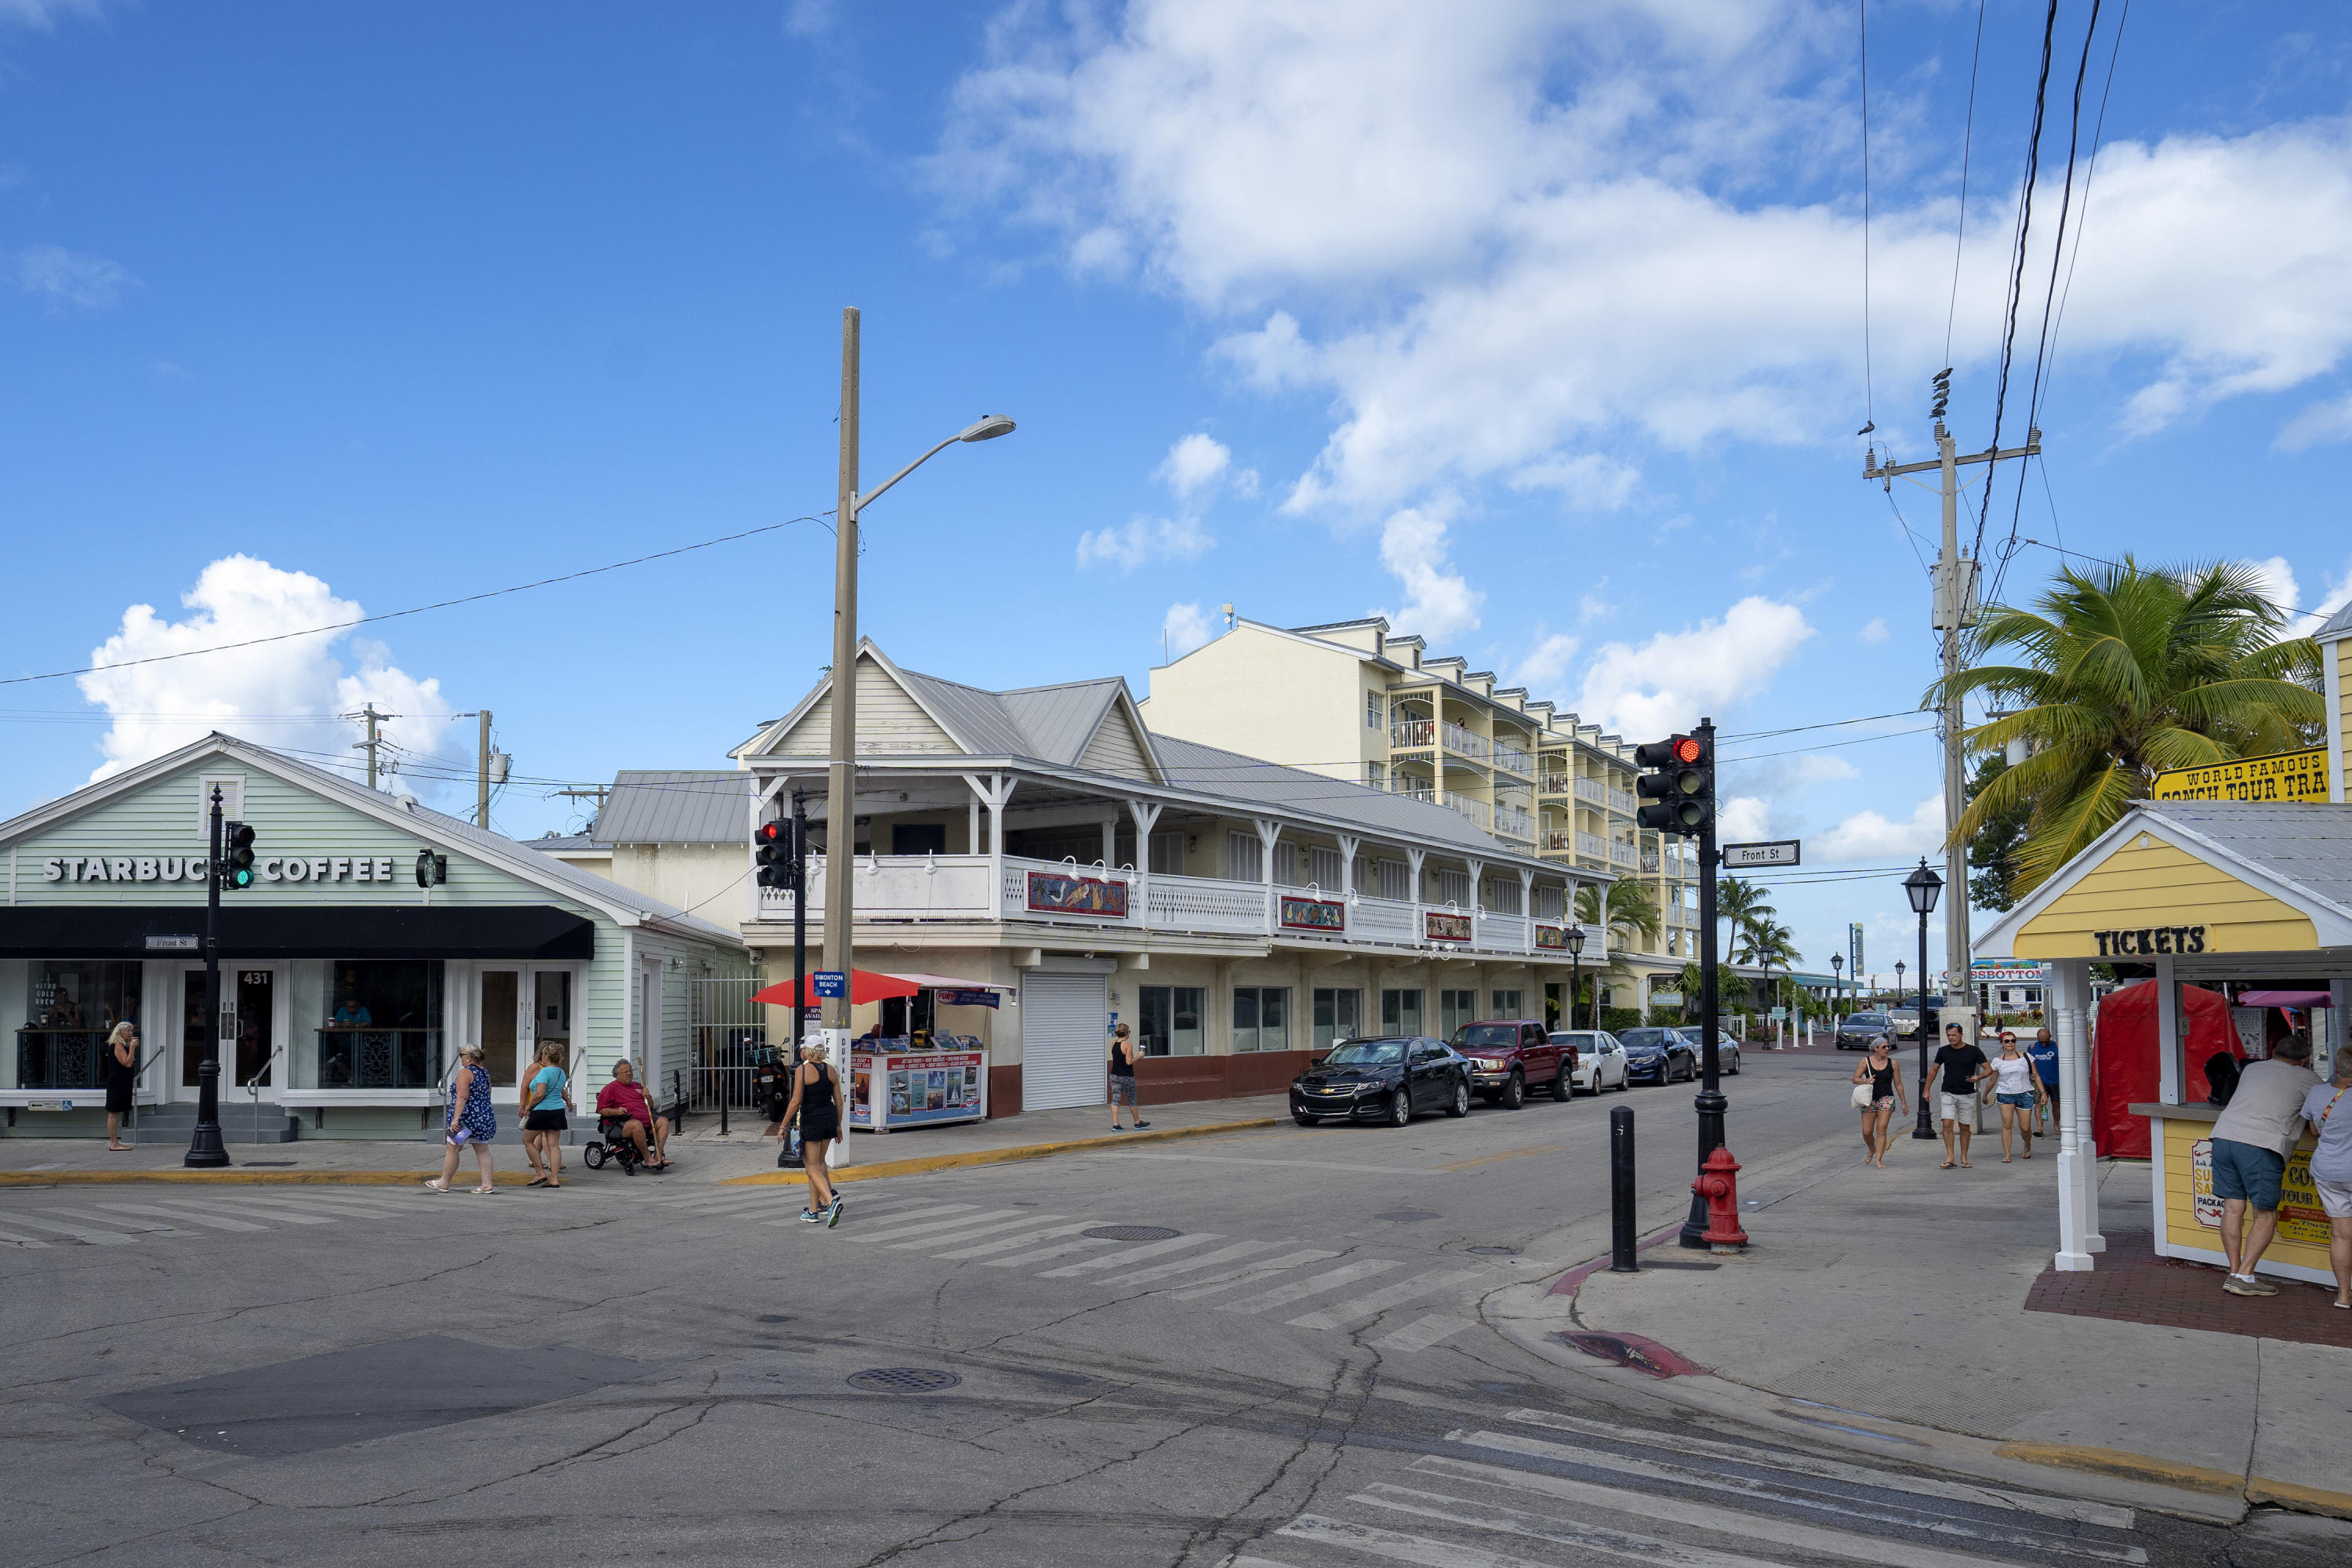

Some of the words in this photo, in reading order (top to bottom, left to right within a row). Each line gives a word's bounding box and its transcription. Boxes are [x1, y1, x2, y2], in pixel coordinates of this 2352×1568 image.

[2187, 766, 2243, 786] WORLD
[2250, 755, 2321, 778] FAMOUS
[2226, 778, 2278, 800] TOUR
[2284, 771, 2329, 797] TRA
[1742, 850, 1765, 861] Front
[1769, 848, 1780, 859] St
[43, 857, 208, 882] STARBUC
[260, 857, 393, 881] COFFEE
[157, 938, 177, 947] Front
[2094, 926, 2205, 956] TICKETS
[244, 972, 267, 984] 431
[2195, 1168, 2212, 1181] SU
[2195, 1181, 2213, 1196] SA
[2198, 1197, 2225, 1207] PACKA
[2282, 1189, 2313, 1205] TOUR
